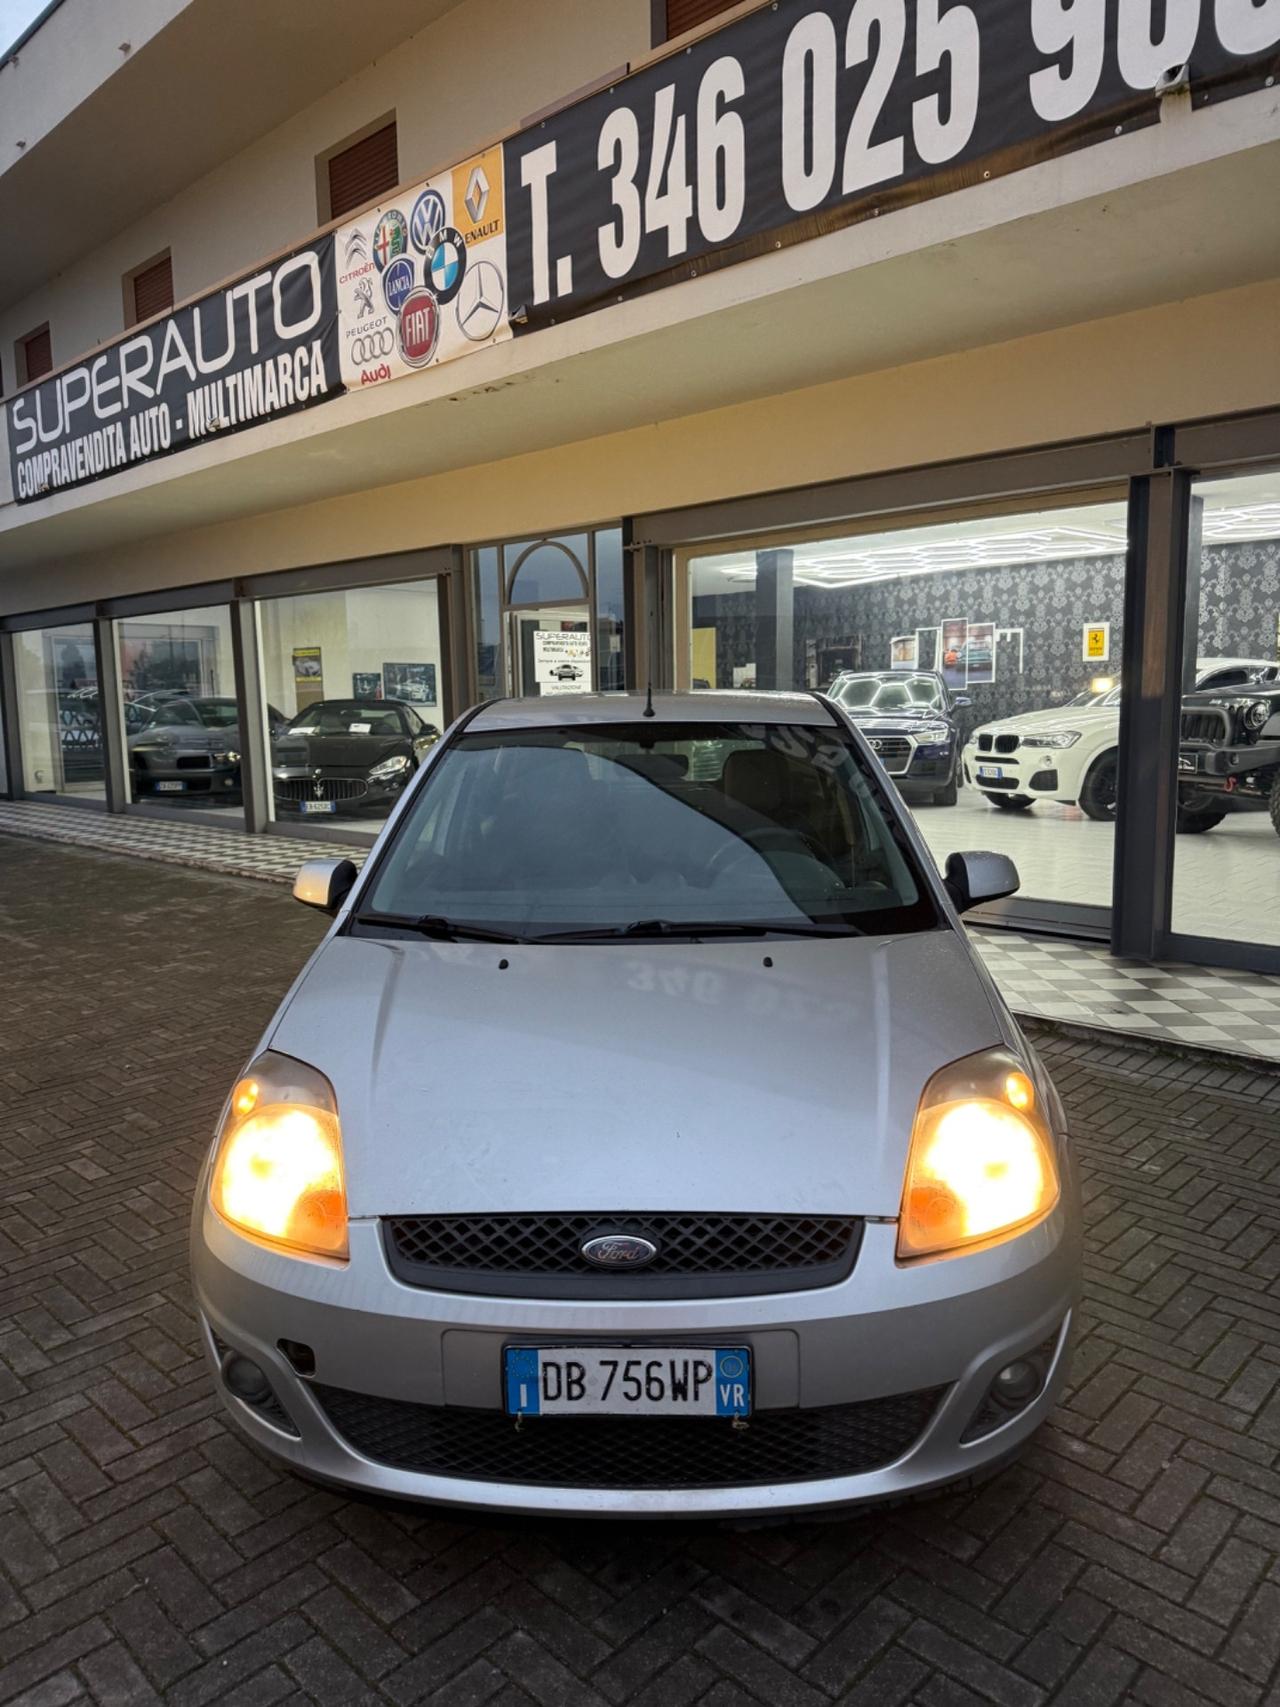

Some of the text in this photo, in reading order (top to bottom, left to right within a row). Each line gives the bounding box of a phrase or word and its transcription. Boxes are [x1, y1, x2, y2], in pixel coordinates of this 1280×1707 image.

[520, 140, 573, 306] T.
[597, 55, 746, 279] 346
[781, 0, 981, 212] 025
[464, 218, 501, 245] ENAULT
[387, 274, 411, 297] LANCIA
[345, 315, 388, 339] PEUGEOT
[404, 307, 431, 348] FIAT
[12, 250, 323, 455] SUPERAUTO
[360, 362, 392, 385] Audi
[17, 420, 127, 499] COMPRAVENDITA
[129, 402, 172, 461] AUTO
[186, 339, 329, 440] MULTIMARCA
[597, 1242, 642, 1260] Ford
[719, 1383, 745, 1408] VR
